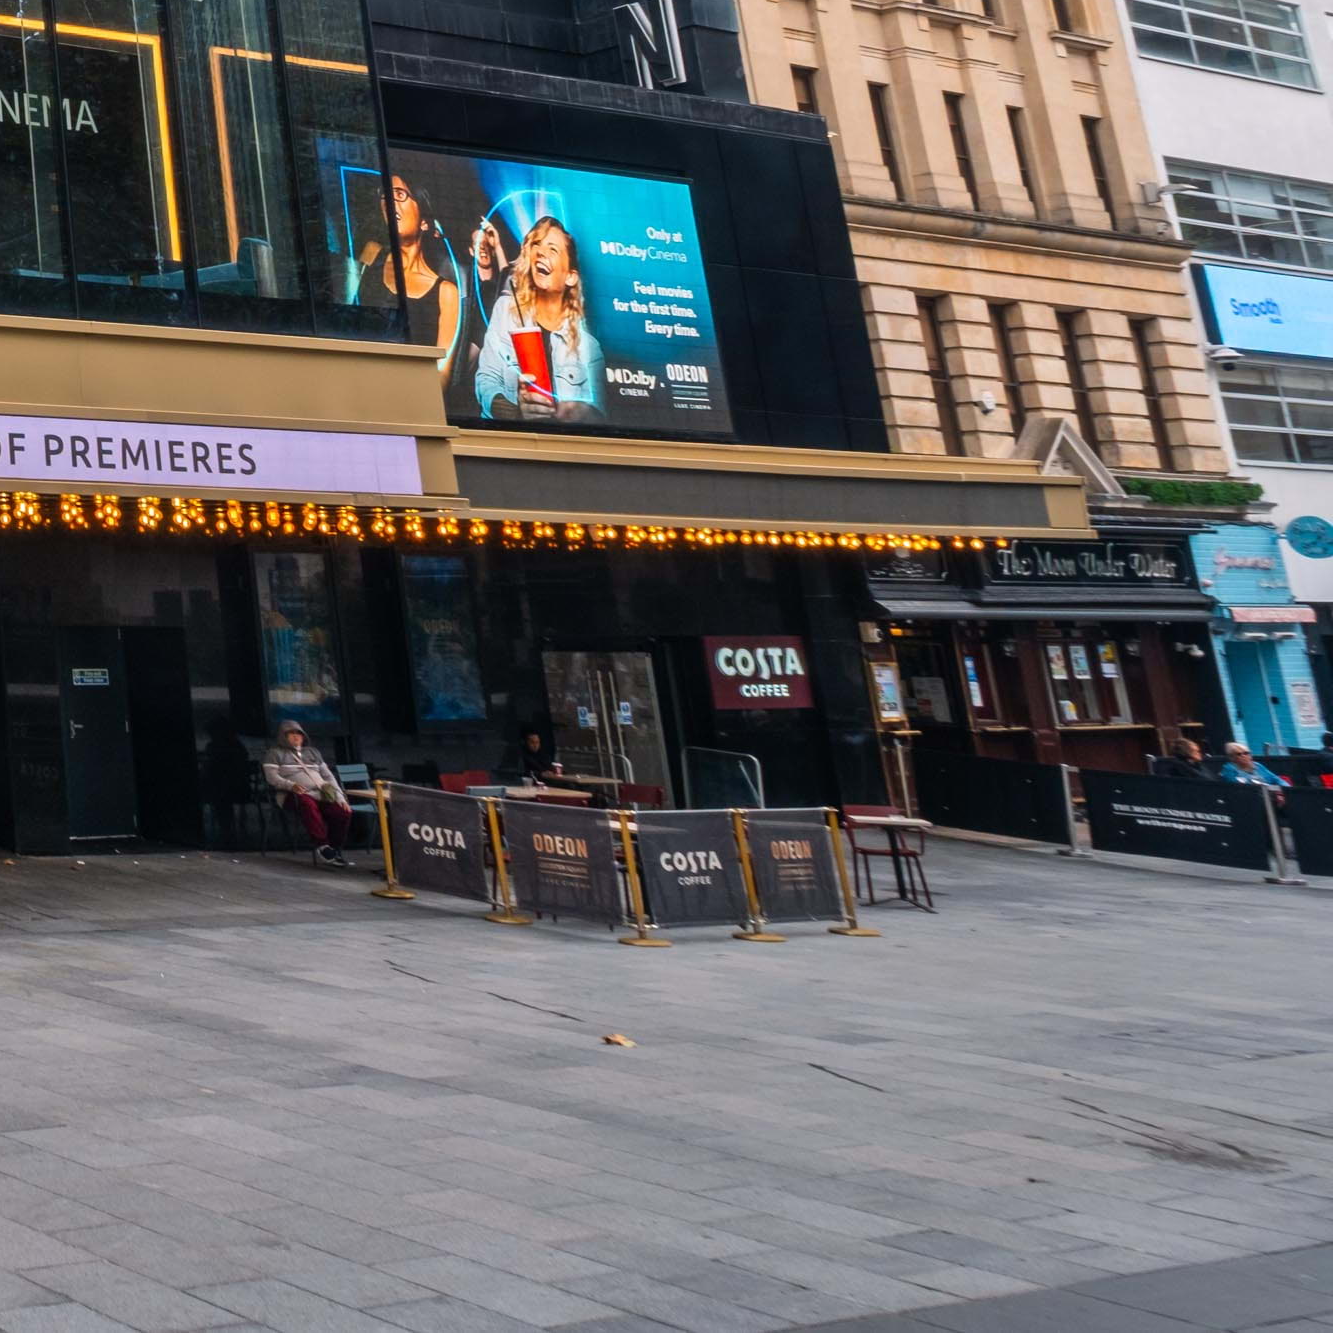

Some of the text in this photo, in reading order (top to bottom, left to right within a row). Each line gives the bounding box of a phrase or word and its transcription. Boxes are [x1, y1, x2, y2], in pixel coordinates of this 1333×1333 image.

[646, 227, 684, 244] Only at
[615, 242, 687, 262] Dolby Cinema
[633, 281, 693, 299] Feel movies
[613, 298, 697, 318] for the first time.
[645, 320, 700, 338] Every time.
[622, 369, 656, 389] Dolby
[666, 363, 709, 383] ODEON
[619, 388, 649, 397] CINEMA
[44, 434, 257, 475] PREMIERES
[997, 540, 1032, 576] The
[715, 647, 805, 680] COSTA
[740, 684, 790, 697] COFFEE
[408, 822, 466, 850] COSTA
[533, 833, 588, 859] ODEON
[423, 846, 457, 860] COFFEE
[770, 840, 812, 860] ODEON
[659, 850, 723, 873] COSTA
[677, 875, 712, 886] COFFEE
